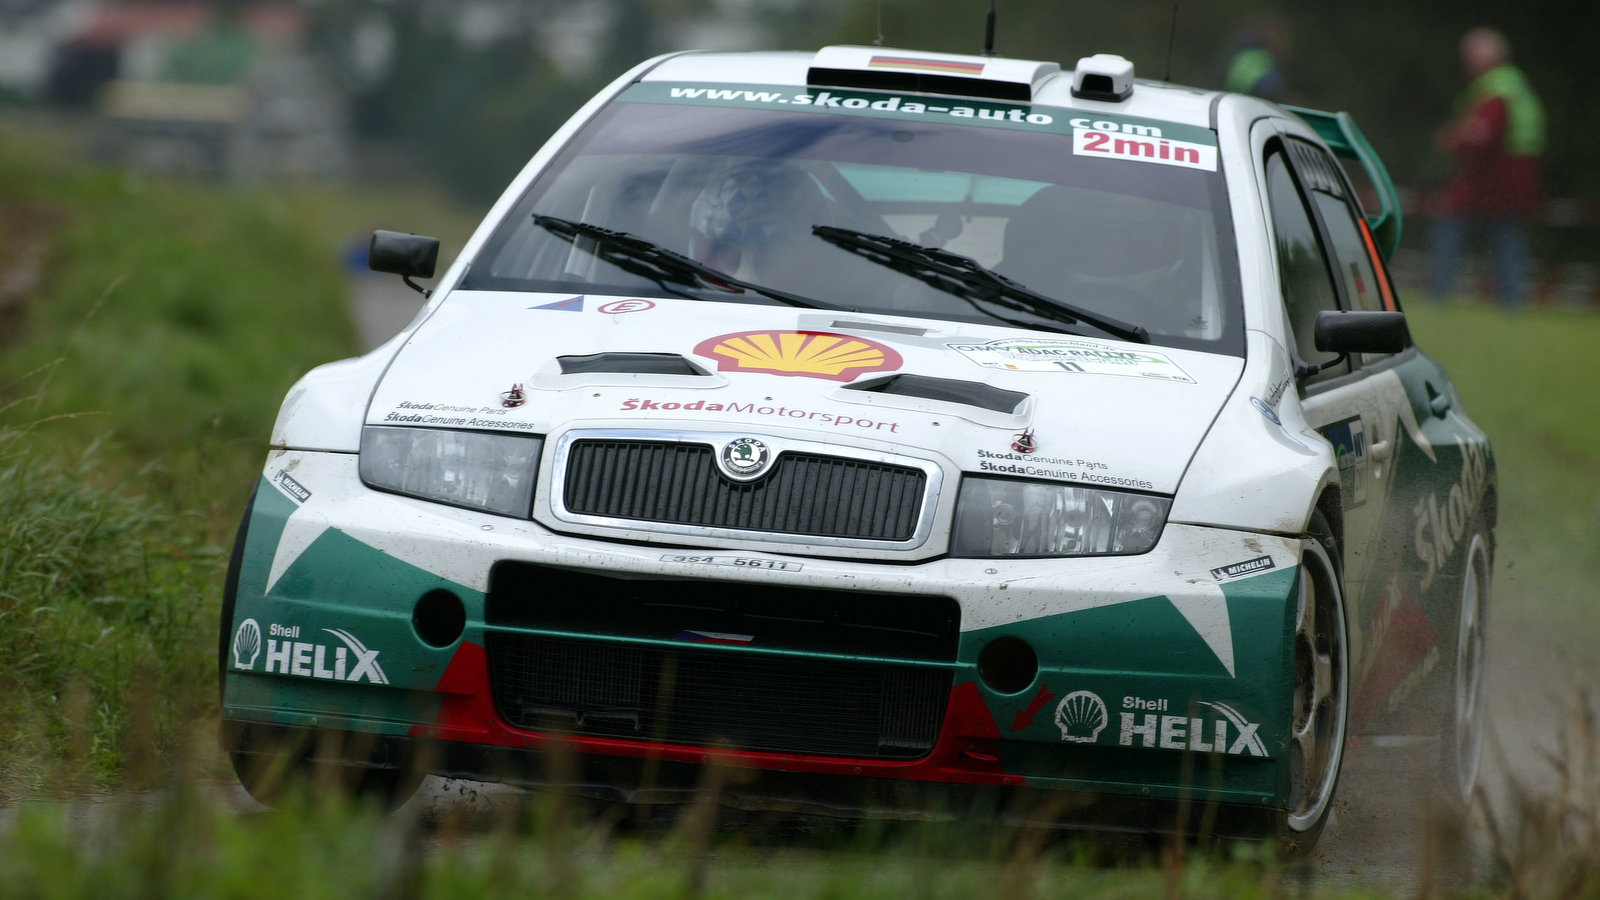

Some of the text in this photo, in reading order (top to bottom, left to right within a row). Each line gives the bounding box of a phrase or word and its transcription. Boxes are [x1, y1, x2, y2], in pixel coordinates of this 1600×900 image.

[1083, 131, 1200, 164] 2min
[1017, 347, 1067, 356] ADAC
[1068, 350, 1142, 360] RALLYE
[1052, 361, 1086, 372] 11
[478, 406, 508, 416] Parts
[467, 417, 535, 430] Accessories
[1076, 459, 1109, 471] Parts
[283, 475, 310, 500] MICHELIN
[1081, 471, 1153, 489] Accessories
[733, 558, 788, 570] 5611
[1228, 557, 1271, 575] MICHELIN
[269, 623, 300, 639] Shell
[265, 629, 390, 684] HELIX
[1122, 695, 1168, 712] Shell
[1119, 702, 1269, 757] HELIX
